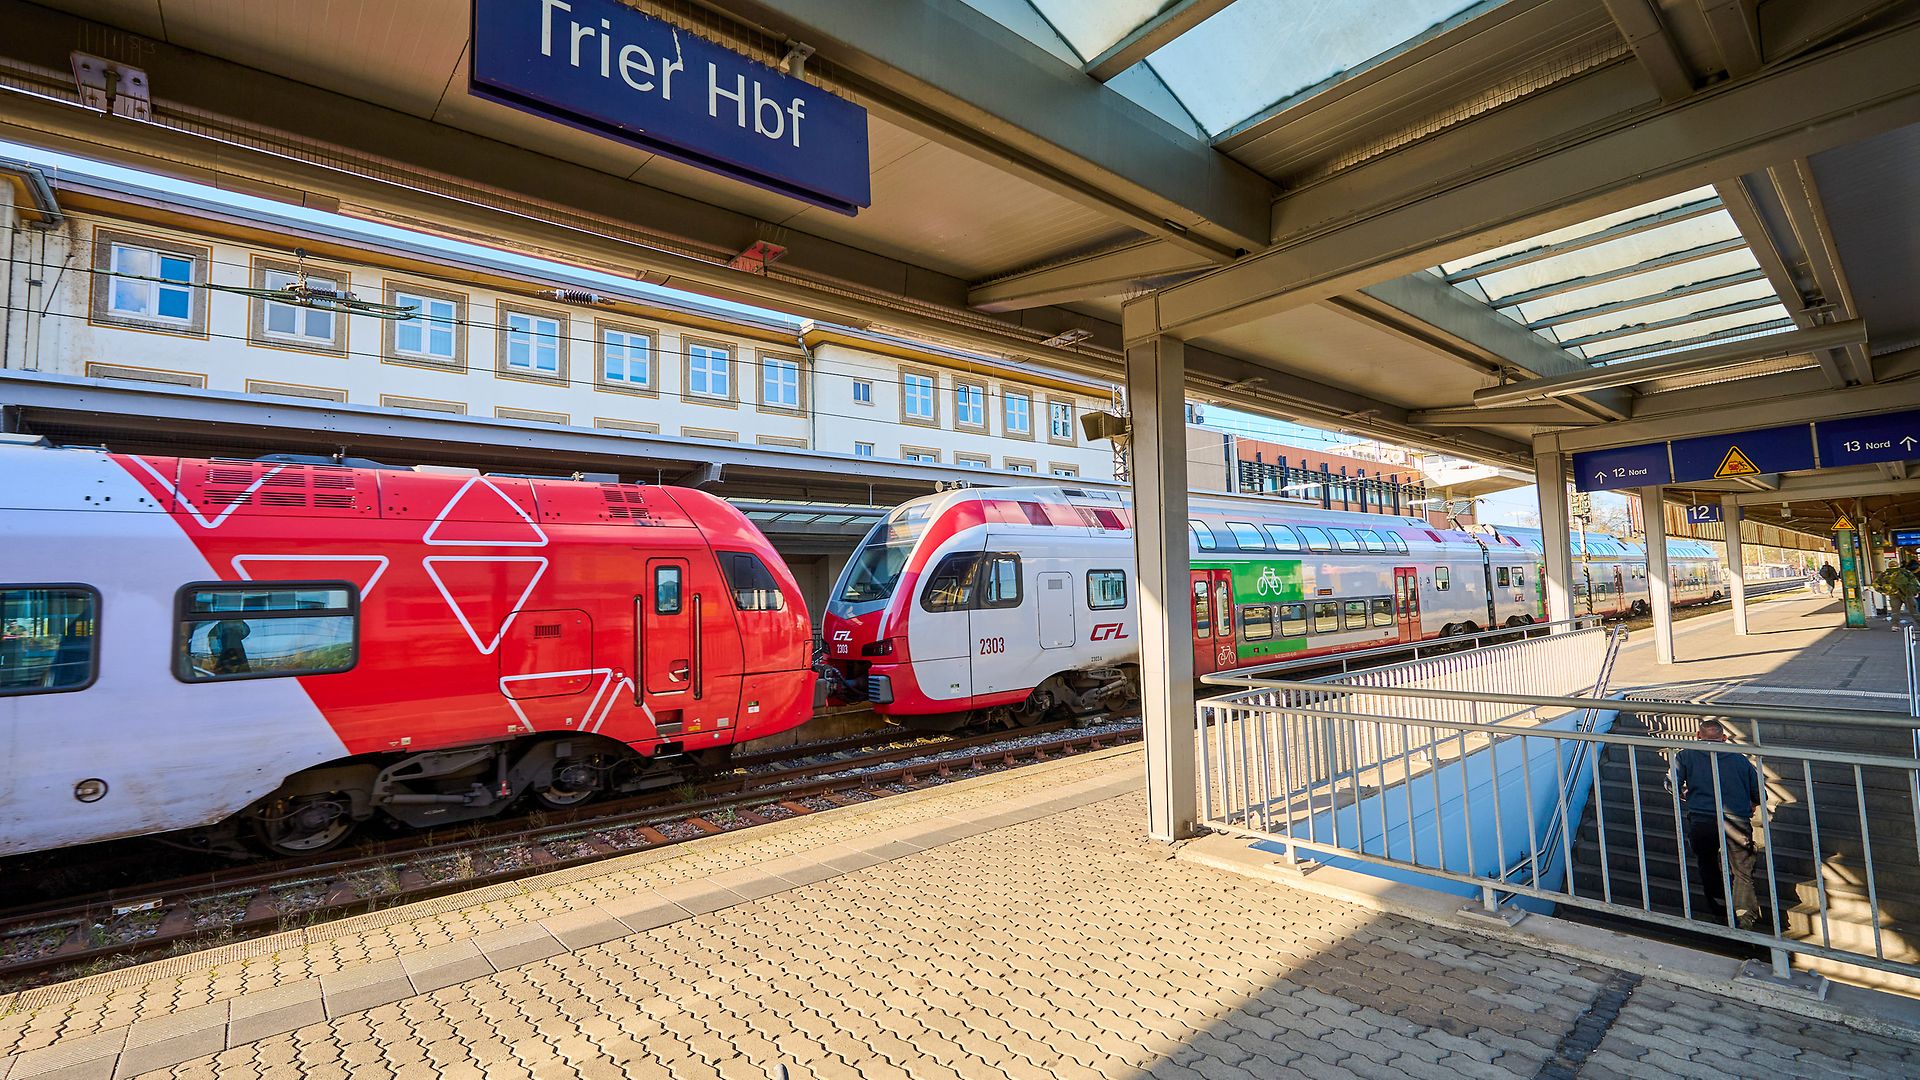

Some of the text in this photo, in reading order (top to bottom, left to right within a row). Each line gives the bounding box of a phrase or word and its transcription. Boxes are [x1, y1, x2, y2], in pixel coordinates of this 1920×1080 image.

[540, 0, 805, 148] Trier Hbf
[1843, 440, 1891, 452] 13 Nord
[1612, 467, 1648, 478] 12 Nord
[1689, 505, 1711, 520] 12
[833, 630, 853, 641] CFL
[1090, 622, 1129, 641] CFL
[980, 637, 1005, 655] 2303
